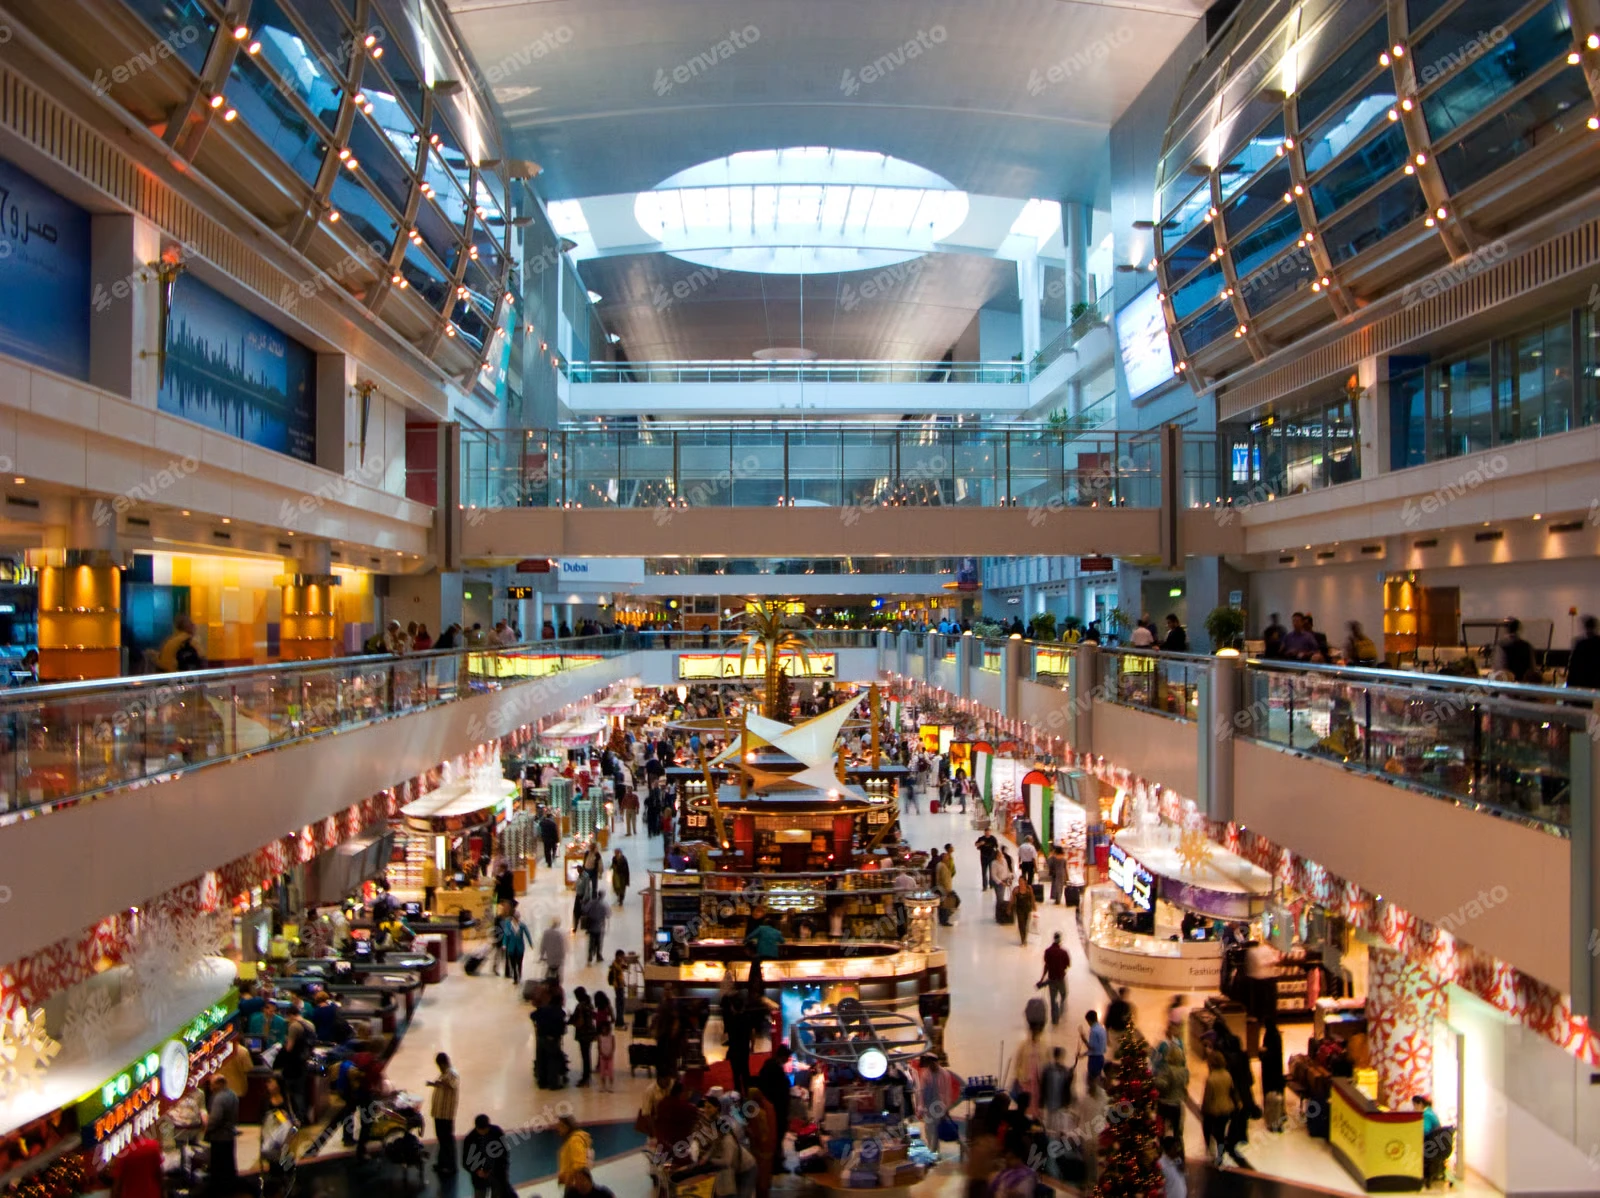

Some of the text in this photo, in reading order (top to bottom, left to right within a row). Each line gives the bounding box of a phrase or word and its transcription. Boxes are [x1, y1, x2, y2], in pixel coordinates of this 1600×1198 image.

[563, 562, 588, 573] Dubai
[94, 1075, 160, 1142] TOBACCO
[101, 1100, 160, 1163] DUTY FREE
